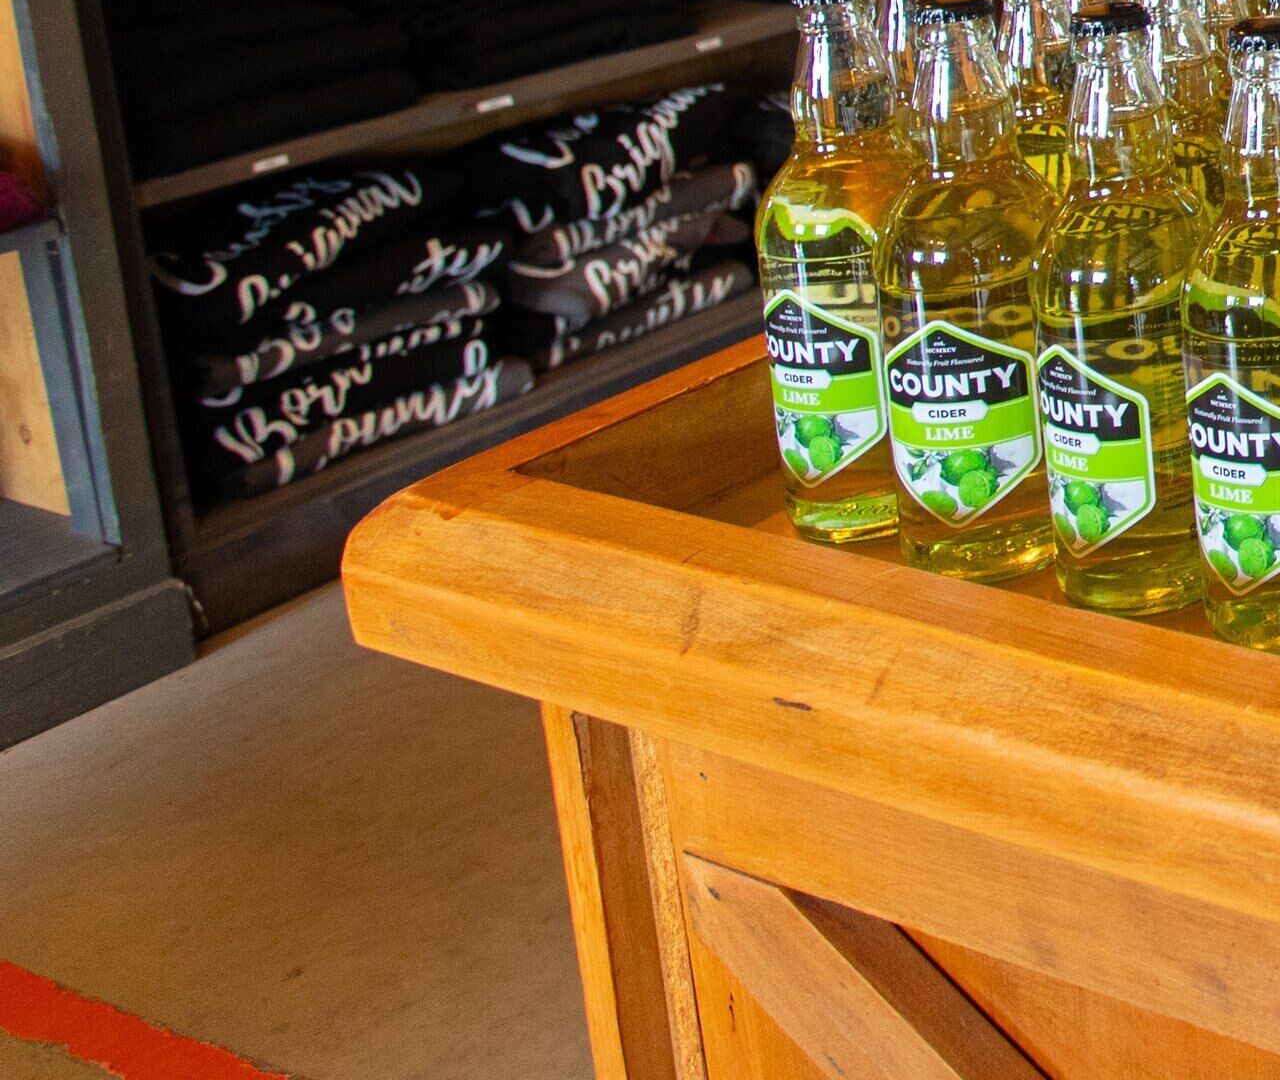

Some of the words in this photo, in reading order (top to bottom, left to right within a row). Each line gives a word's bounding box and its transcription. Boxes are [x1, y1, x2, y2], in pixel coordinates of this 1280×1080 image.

[766, 330, 860, 364] OUNTY
[784, 372, 813, 384] CIDER
[890, 363, 1016, 397] COUNTY
[783, 389, 820, 405] LIME
[928, 408, 966, 419] CIDER
[1040, 392, 1128, 428] OUNTY
[925, 426, 975, 441] LIME
[1054, 434, 1081, 448] CIDER
[1053, 451, 1088, 472] LIME
[1213, 466, 1246, 479] CIDER
[1210, 484, 1253, 504] LIME
